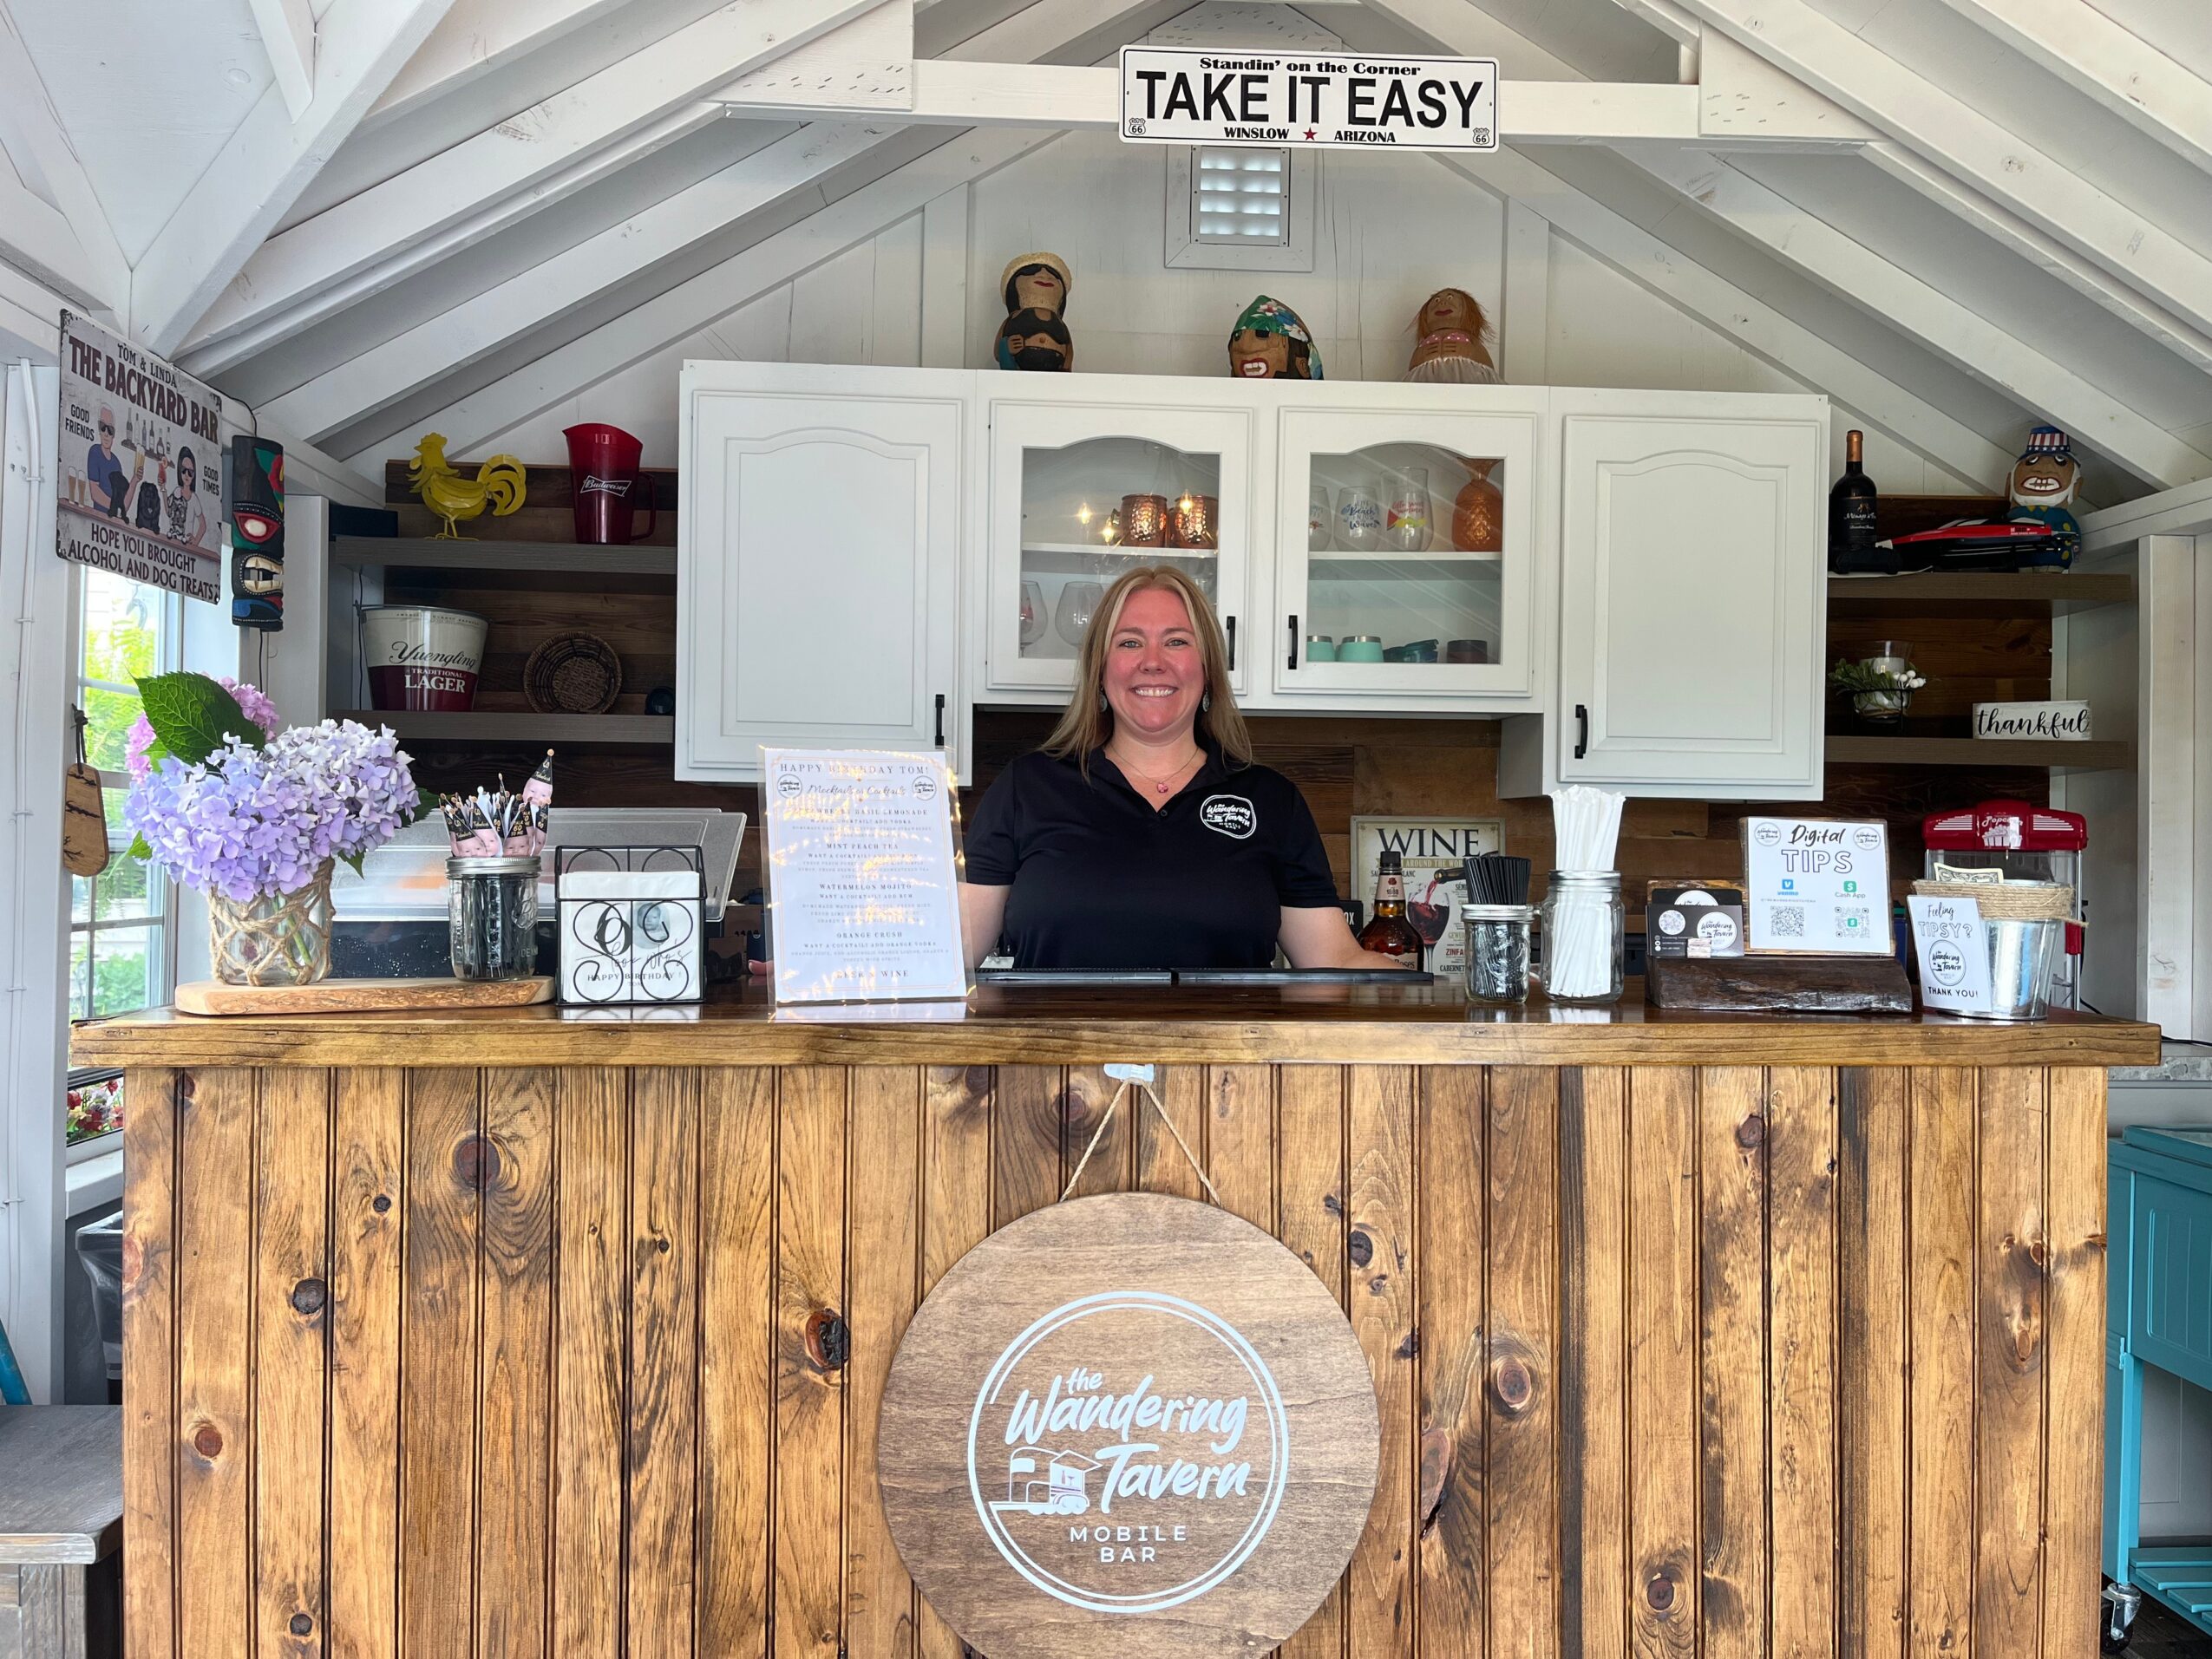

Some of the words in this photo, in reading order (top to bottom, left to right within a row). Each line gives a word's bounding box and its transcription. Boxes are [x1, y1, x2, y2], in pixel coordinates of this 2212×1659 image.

[1286, 62, 1311, 73] on
[1317, 62, 1348, 75] the
[1353, 63, 1421, 76] Corner
[1136, 70, 1269, 122] TAKE
[1288, 75, 1331, 124] IT
[1348, 77, 1483, 128] EASY
[1131, 125, 1143, 134] 66
[1224, 127, 1290, 140] WINSLOW
[1334, 130, 1397, 143] ARIZONA
[1476, 134, 1487, 143] 66
[117, 342, 136, 366] TOM
[141, 356, 147, 373] &
[150, 362, 178, 389] LINDA
[69, 334, 101, 386] THE
[105, 354, 187, 428] BACKYARD
[190, 400, 219, 445] BAR
[71, 403, 90, 423] GOOD
[65, 417, 95, 442] FRIENDS
[203, 465, 219, 482] GOOD
[202, 479, 219, 497] TIMES
[585, 479, 627, 491] Budweiser
[91, 522, 120, 550] HOPE
[122, 533, 144, 558] YOU
[147, 543, 196, 574] BROUGHT
[68, 539, 123, 573] ALCOHOL
[127, 558, 149, 581] AND
[153, 565, 177, 590] DOG
[180, 575, 213, 600] TREATS
[389, 641, 476, 670] Yuengling
[412, 668, 463, 679] TRADITIONAL
[404, 674, 466, 693] LAGER
[1978, 709, 2090, 740] thankful
[781, 763, 822, 773] HAPPY
[828, 764, 893, 774] BIRHDAY
[899, 766, 929, 774] TOM!
[806, 784, 854, 795] Mocktails
[867, 787, 906, 797] Cocktails
[1207, 805, 1251, 819] Wandering
[1223, 813, 1251, 827] Tavern
[1981, 815, 2024, 826] Popcn
[1376, 827, 1481, 858] WINE
[1788, 824, 1846, 847] Digital
[1781, 849, 1853, 873] TIPS
[1927, 902, 1956, 921] Feeling
[1918, 921, 1973, 938] TIPSY?
[1932, 953, 1960, 964] Wandering
[1942, 961, 1961, 970] Tavern
[587, 973, 619, 982] HAPPY
[1927, 986, 1953, 996] THANK
[1956, 990, 1979, 998] YOU!
[1066, 1367, 1103, 1394] the
[1005, 1374, 1247, 1455] Wandering
[1095, 1442, 1251, 1514] Tavern
[1070, 1525, 1187, 1542] MOBILE
[1100, 1546, 1156, 1563] BAR
